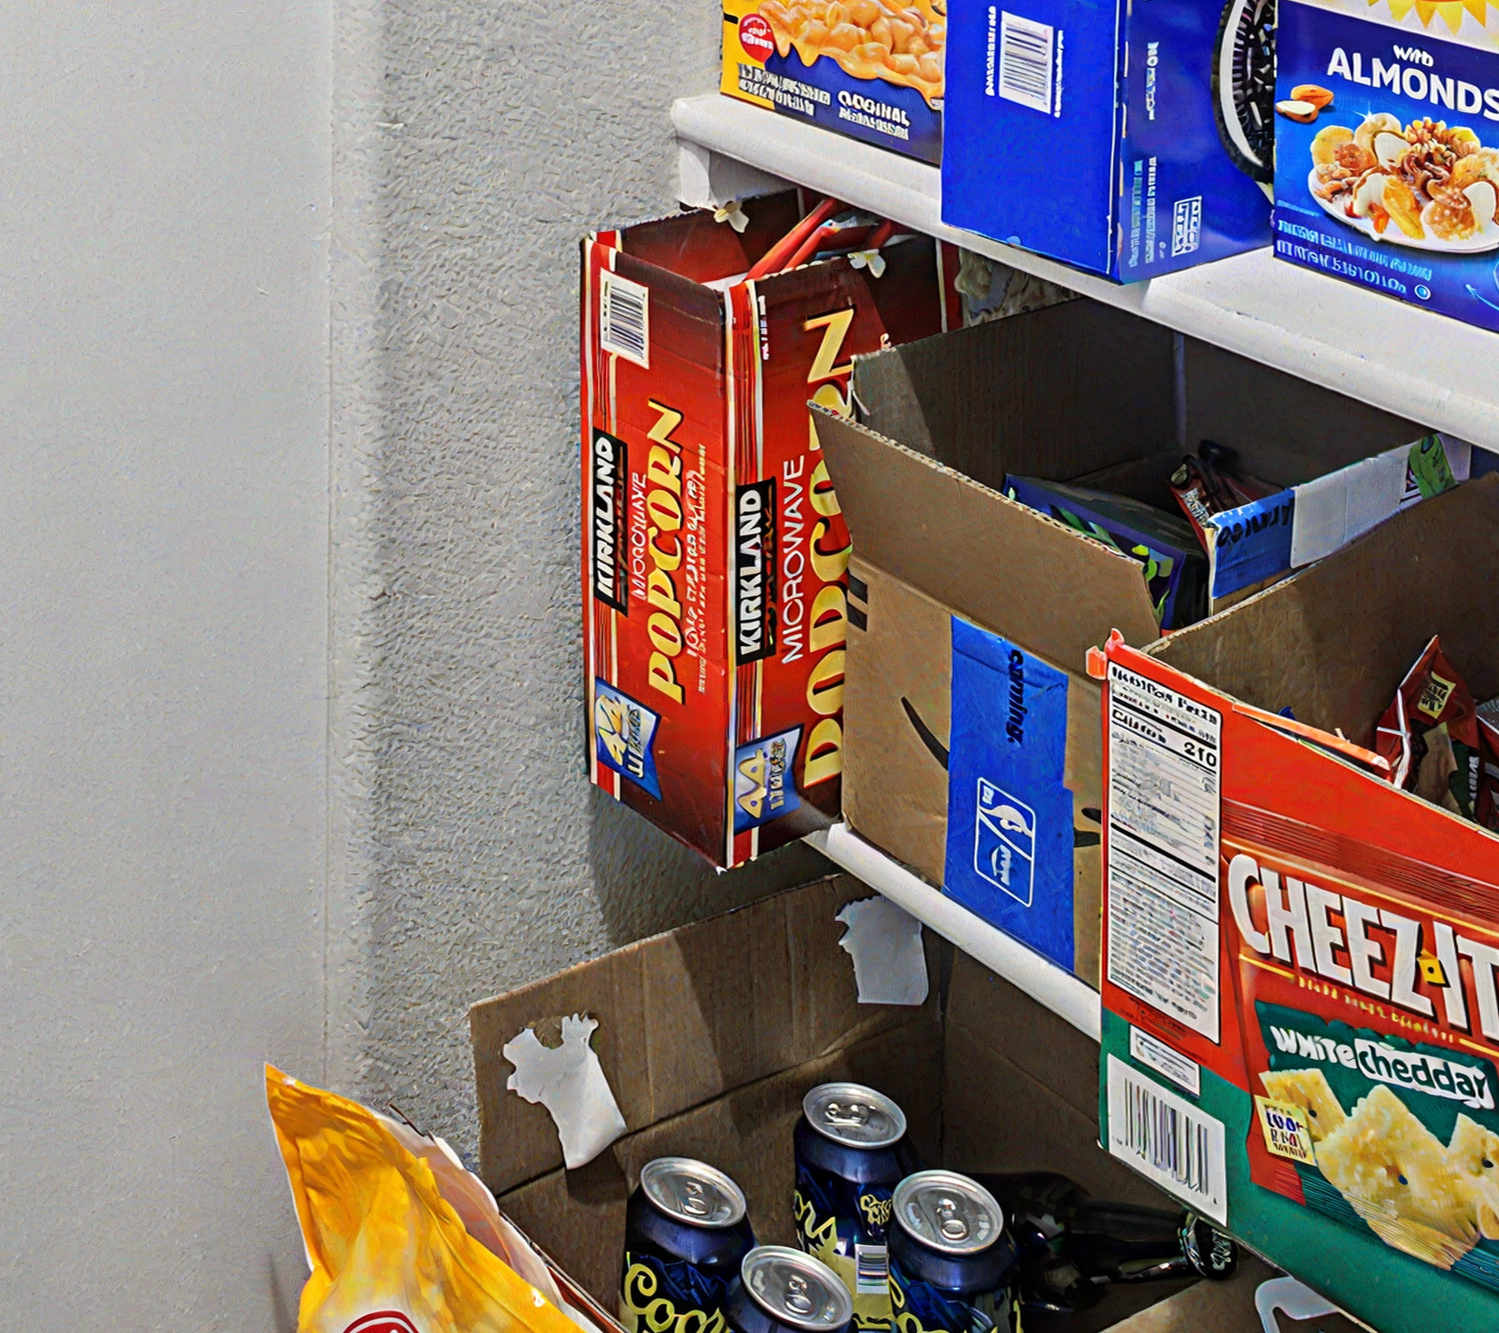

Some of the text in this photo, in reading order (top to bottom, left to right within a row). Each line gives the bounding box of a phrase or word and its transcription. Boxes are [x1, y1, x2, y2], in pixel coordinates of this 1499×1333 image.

[593, 436, 615, 598] KIRKLAND
[647, 398, 685, 705] POPCORN
[739, 489, 762, 656] KIRKLAND
[780, 454, 806, 665] MICROWAVE
